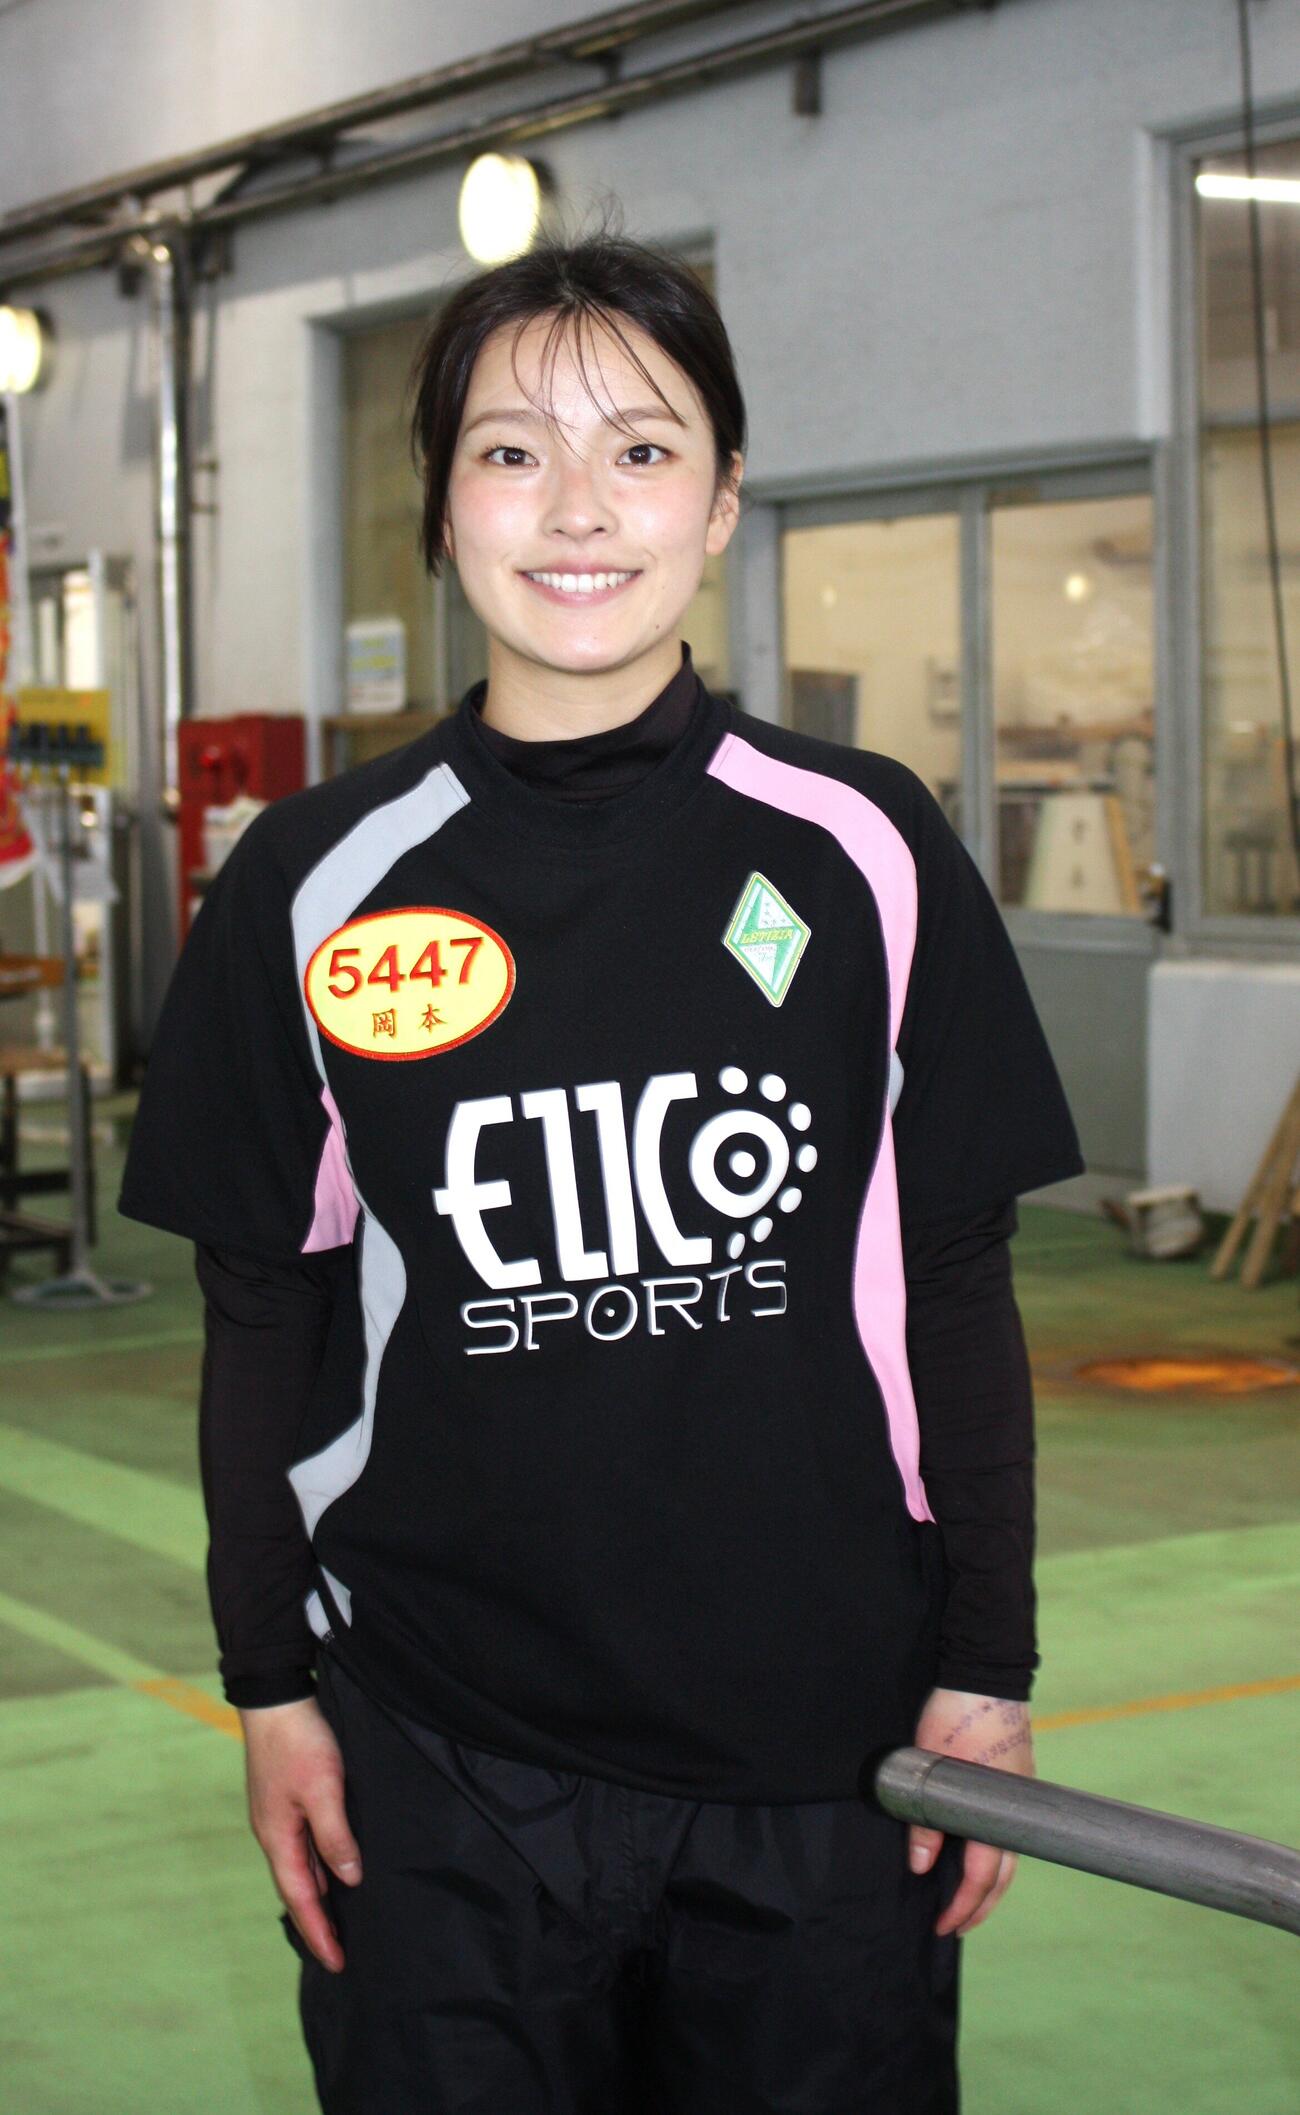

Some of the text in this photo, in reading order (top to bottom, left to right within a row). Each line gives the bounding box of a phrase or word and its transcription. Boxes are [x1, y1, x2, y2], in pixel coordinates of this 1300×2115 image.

[327, 936, 484, 1000] 5447
[371, 1003, 448, 1038] 岡本
[461, 1259, 787, 1355] SPORTS
